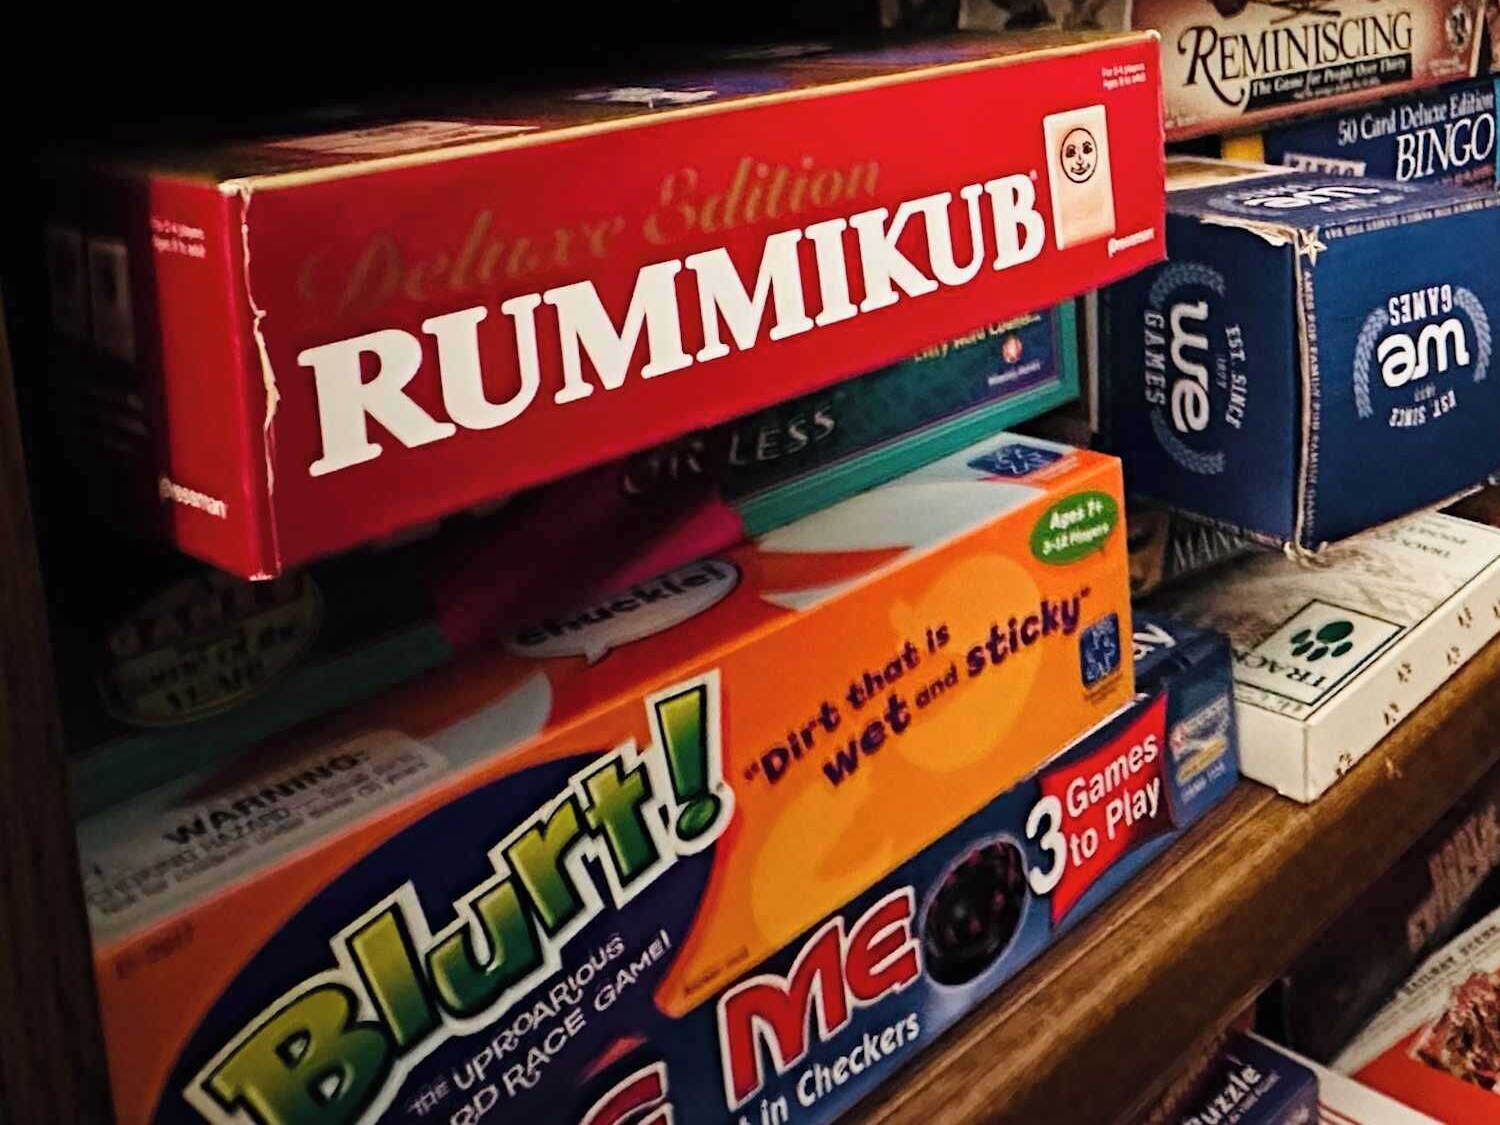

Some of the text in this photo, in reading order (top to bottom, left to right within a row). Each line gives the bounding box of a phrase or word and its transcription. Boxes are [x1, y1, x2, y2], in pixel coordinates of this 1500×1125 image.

[1176, 10, 1413, 107] REMINISCING
[1252, 77, 1272, 98] The
[1337, 120, 1358, 147] 50
[1360, 109, 1397, 141] Card
[1399, 99, 1447, 128] Deluxe
[1450, 89, 1495, 117] Edition
[1395, 112, 1496, 182] BINGO
[297, 208, 625, 317] Deluxe
[642, 155, 880, 246] Edition
[297, 173, 1046, 478] RUMMIKUB
[1388, 283, 1454, 326] GAMES
[1143, 310, 1166, 406] GAMES
[1169, 299, 1210, 433] we
[1376, 315, 1470, 389] we
[728, 409, 835, 465] LESS
[1225, 371, 1248, 430] SINCE
[1049, 505, 1086, 531] Ages
[1070, 521, 1111, 546] Players
[848, 641, 921, 712] that
[924, 621, 952, 655] is
[821, 692, 912, 790] wet
[914, 661, 960, 712] and
[1066, 731, 1160, 818] Games
[1066, 778, 1163, 869] to Play
[183, 669, 737, 1125] Blurt!
[406, 1080, 449, 1117] THE
[452, 932, 626, 1090] UPROARIOUS
[501, 1005, 588, 1098] RACE
[593, 928, 673, 1013] GAME!
[716, 885, 924, 1113] ME
[796, 1011, 921, 1109] Checkers
